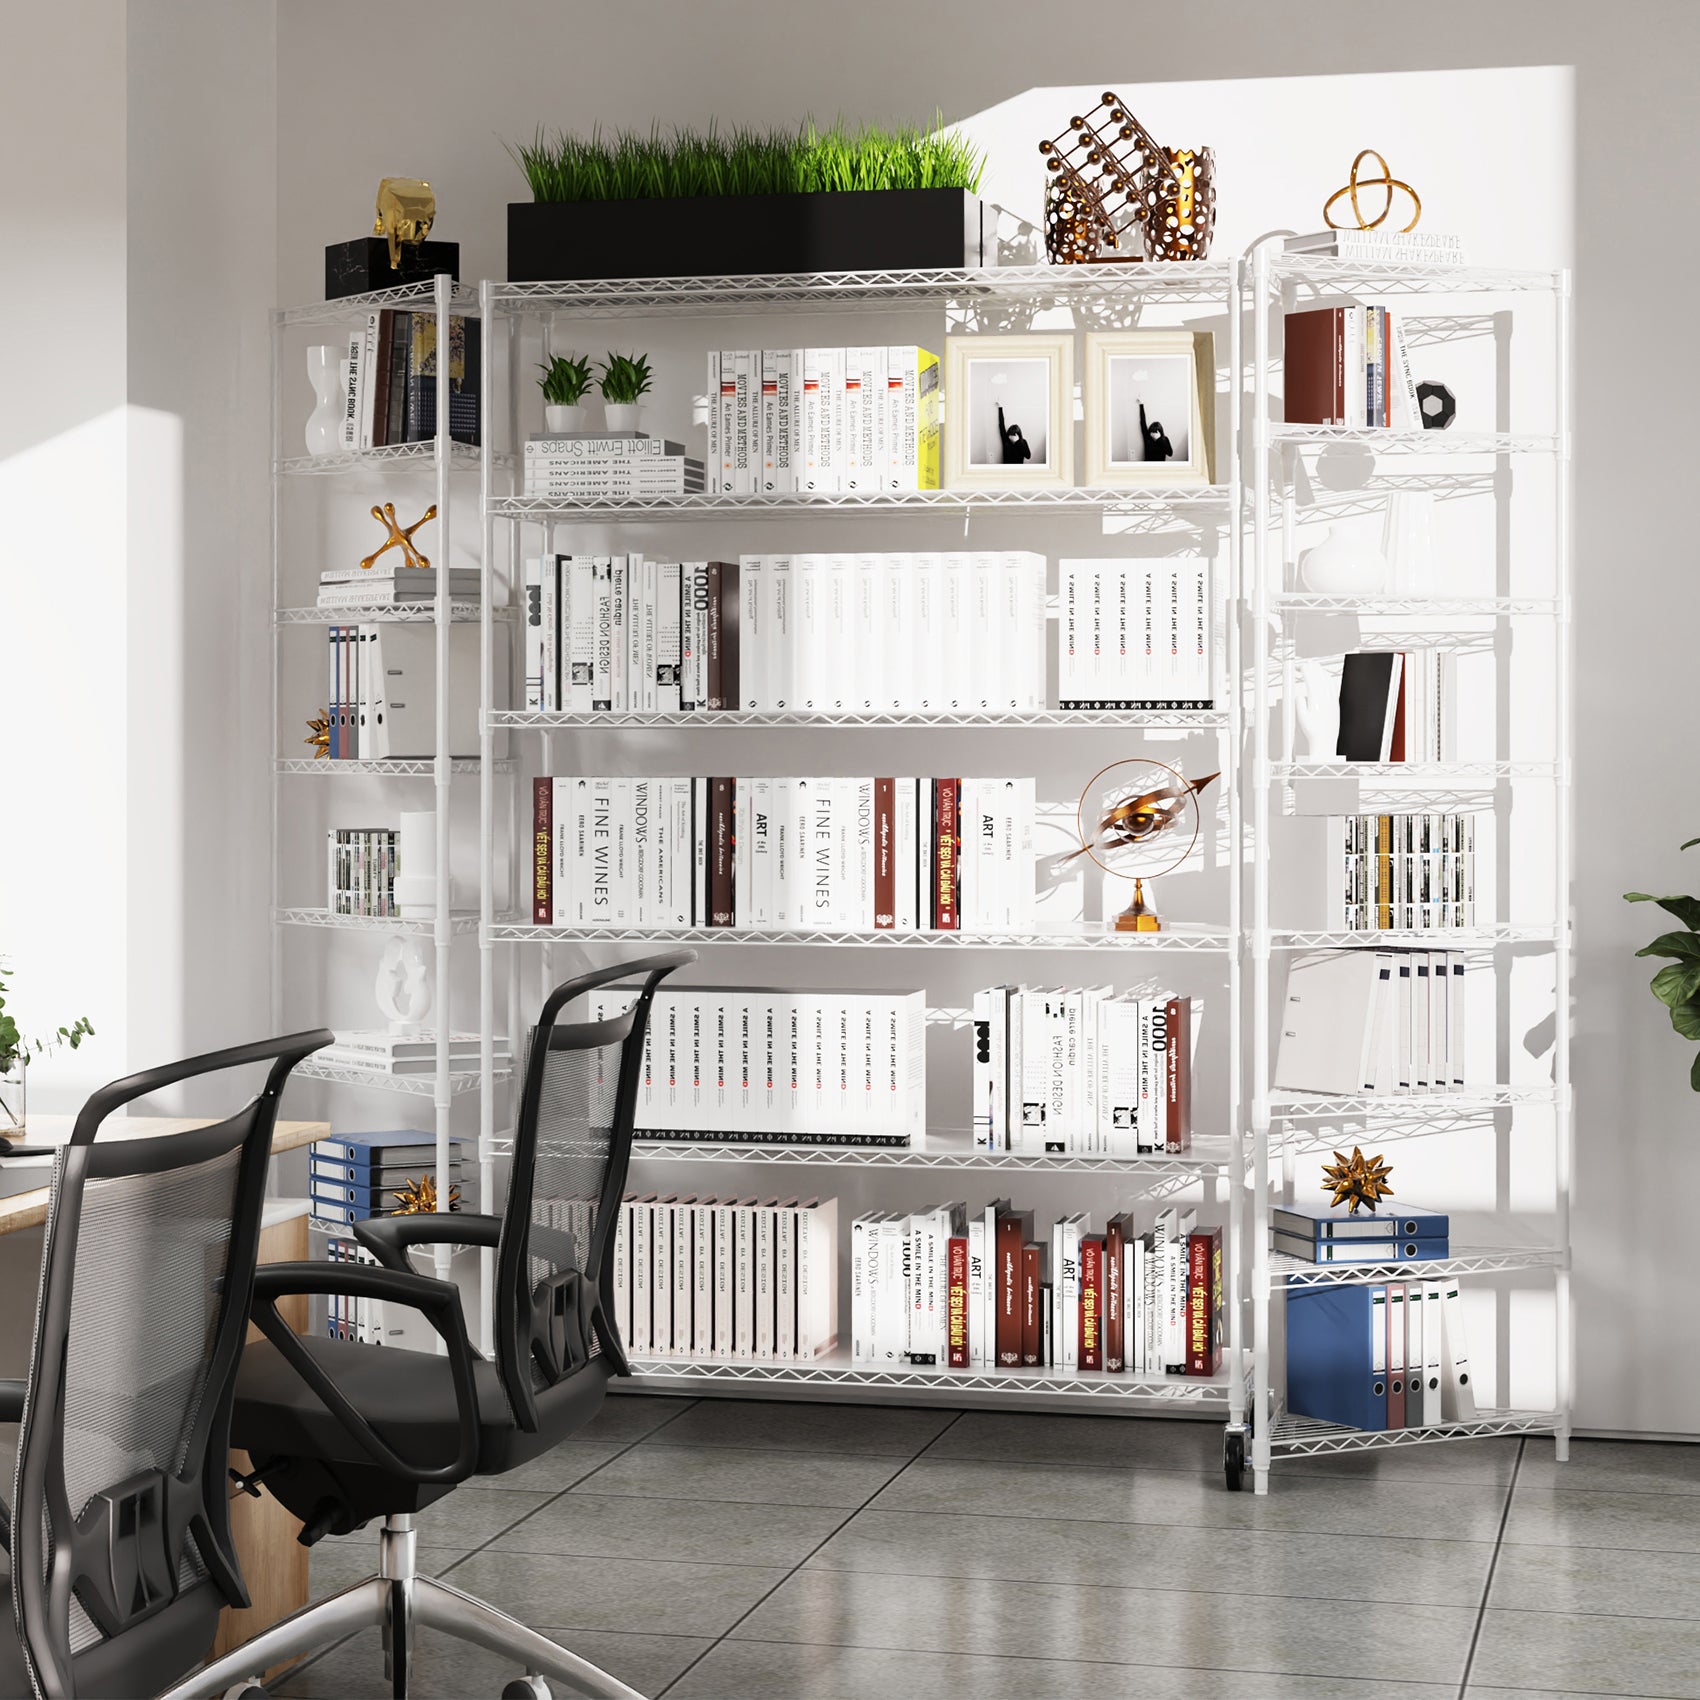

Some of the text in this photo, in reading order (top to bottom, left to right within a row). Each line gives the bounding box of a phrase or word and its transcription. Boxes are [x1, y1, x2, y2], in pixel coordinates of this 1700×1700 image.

[766, 402, 773, 410] An
[724, 403, 732, 457] An Eames Primer
[737, 374, 747, 469] MOVIES AND METHODS
[779, 372, 789, 468] MOVIES AND METHODS
[541, 440, 661, 457] Elliott Erwitt Snaps
[636, 782, 648, 843] WINDOWS
[858, 784, 870, 845] WINDOWS
[756, 813, 768, 837] ART
[982, 815, 994, 838] ART
[594, 798, 609, 906] FINE WINES
[815, 799, 830, 908] FINE WINES
[868, 1228, 879, 1285] WINDOWS
[914, 1237, 922, 1260] SMILE
[1154, 1224, 1165, 1287] WINDOWS
[914, 1262, 922, 1271] IN
[971, 1256, 982, 1279] ART
[1064, 1258, 1074, 1281] ART
[1179, 1268, 1186, 1277] IN
[914, 1272, 922, 1287] THE
[914, 1288, 922, 1310] MIND
